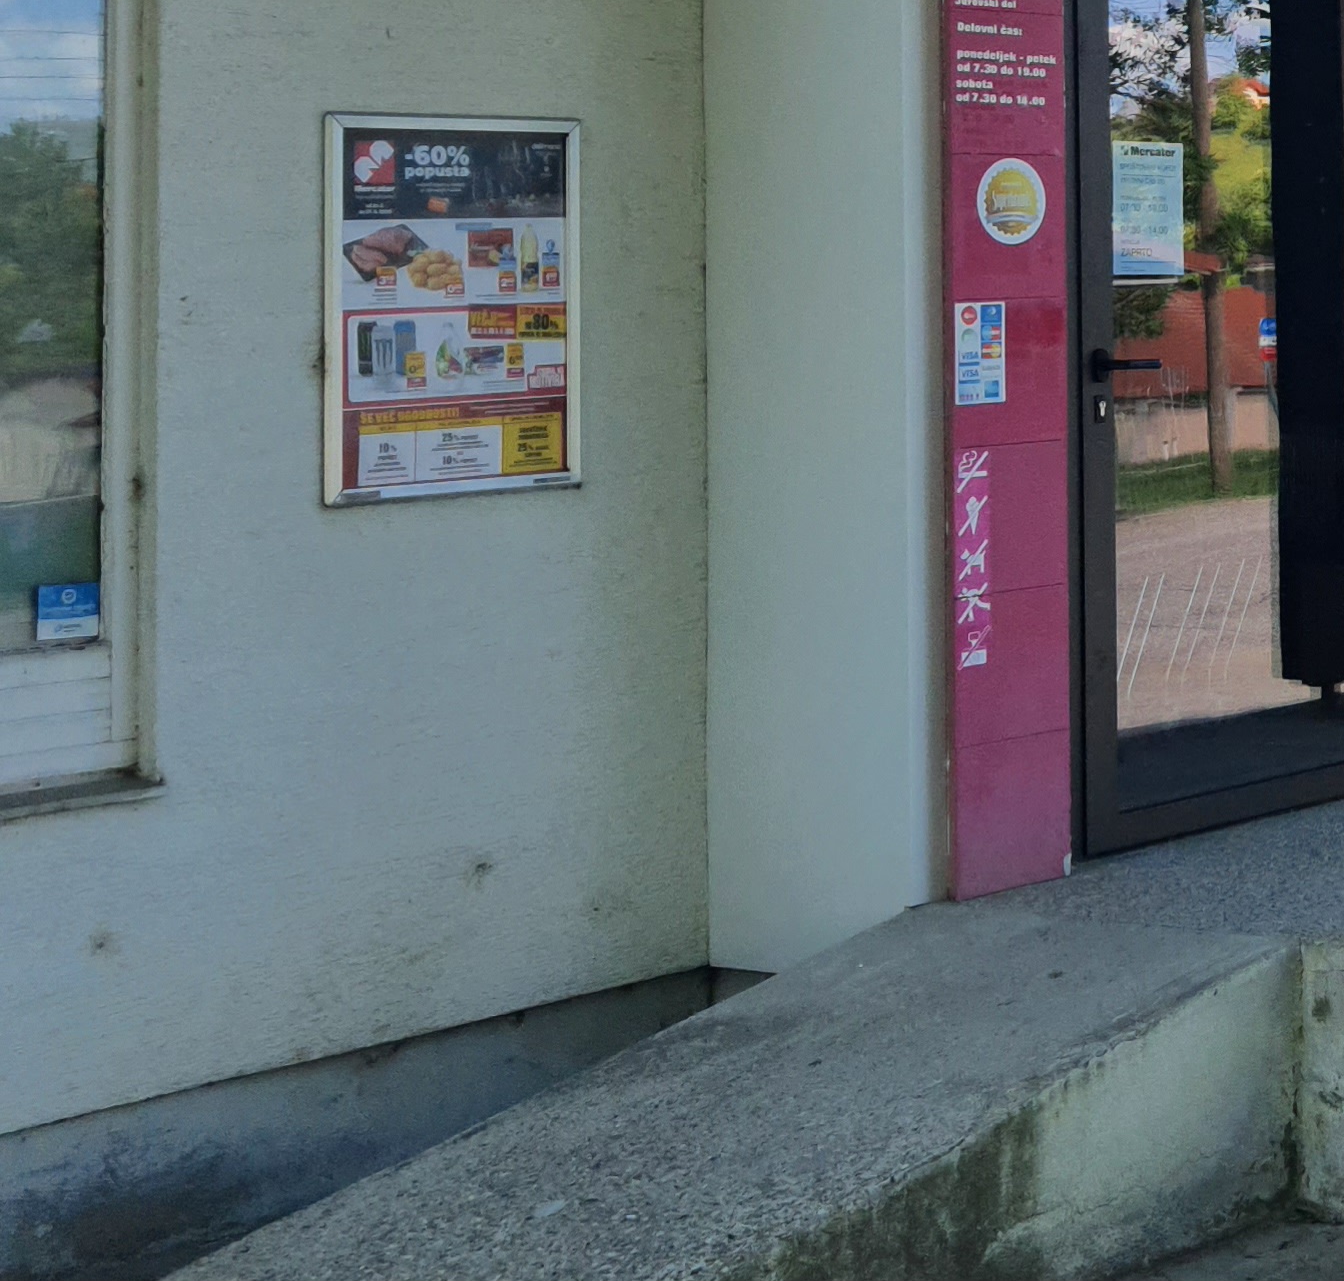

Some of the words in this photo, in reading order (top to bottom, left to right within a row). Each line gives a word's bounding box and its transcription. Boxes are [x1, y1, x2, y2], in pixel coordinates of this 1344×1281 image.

[1001, 0, 1017, 9] dol
[957, 21, 998, 34] Delovni
[1000, 22, 1023, 36] čas:
[956, 49, 1017, 63] ponedeljek
[1026, 53, 1057, 65] petek
[956, 63, 970, 72] od
[973, 62, 998, 74] 7.30
[1000, 65, 1014, 75] do
[956, 78, 994, 89] sobota
[956, 93, 970, 102] od
[972, 92, 997, 103] 7.30
[999, 94, 1013, 104] do
[404, 145, 470, 166] -60%
[1130, 145, 1176, 157] Mercator
[404, 166, 470, 179] popusta
